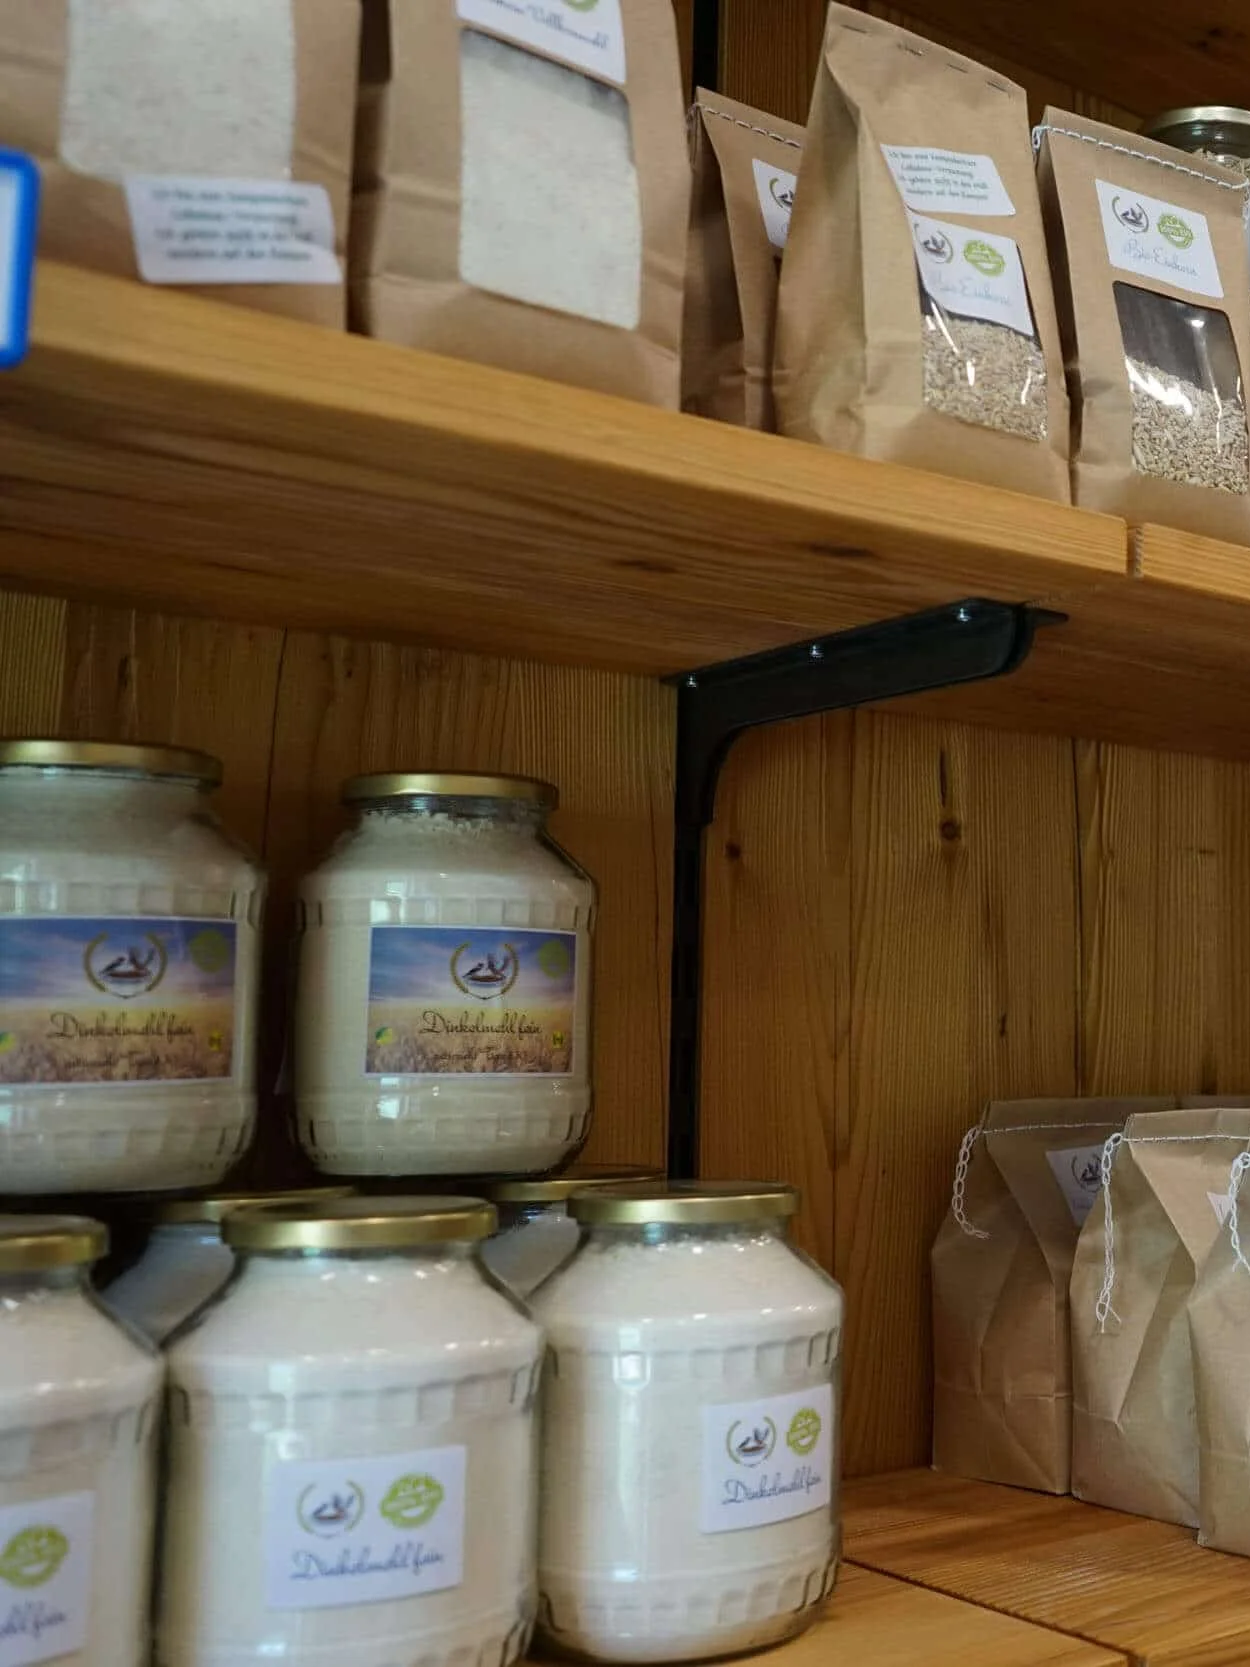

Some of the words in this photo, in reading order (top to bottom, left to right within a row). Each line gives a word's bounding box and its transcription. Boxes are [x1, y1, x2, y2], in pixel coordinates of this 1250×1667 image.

[48, 1011, 168, 1039] Dinkelmehl
[419, 1010, 514, 1035] Dinkelmehl
[516, 1014, 543, 1041] fein
[721, 1466, 806, 1505] Dinkelmehl
[290, 1540, 411, 1581] Dinkelmehl
